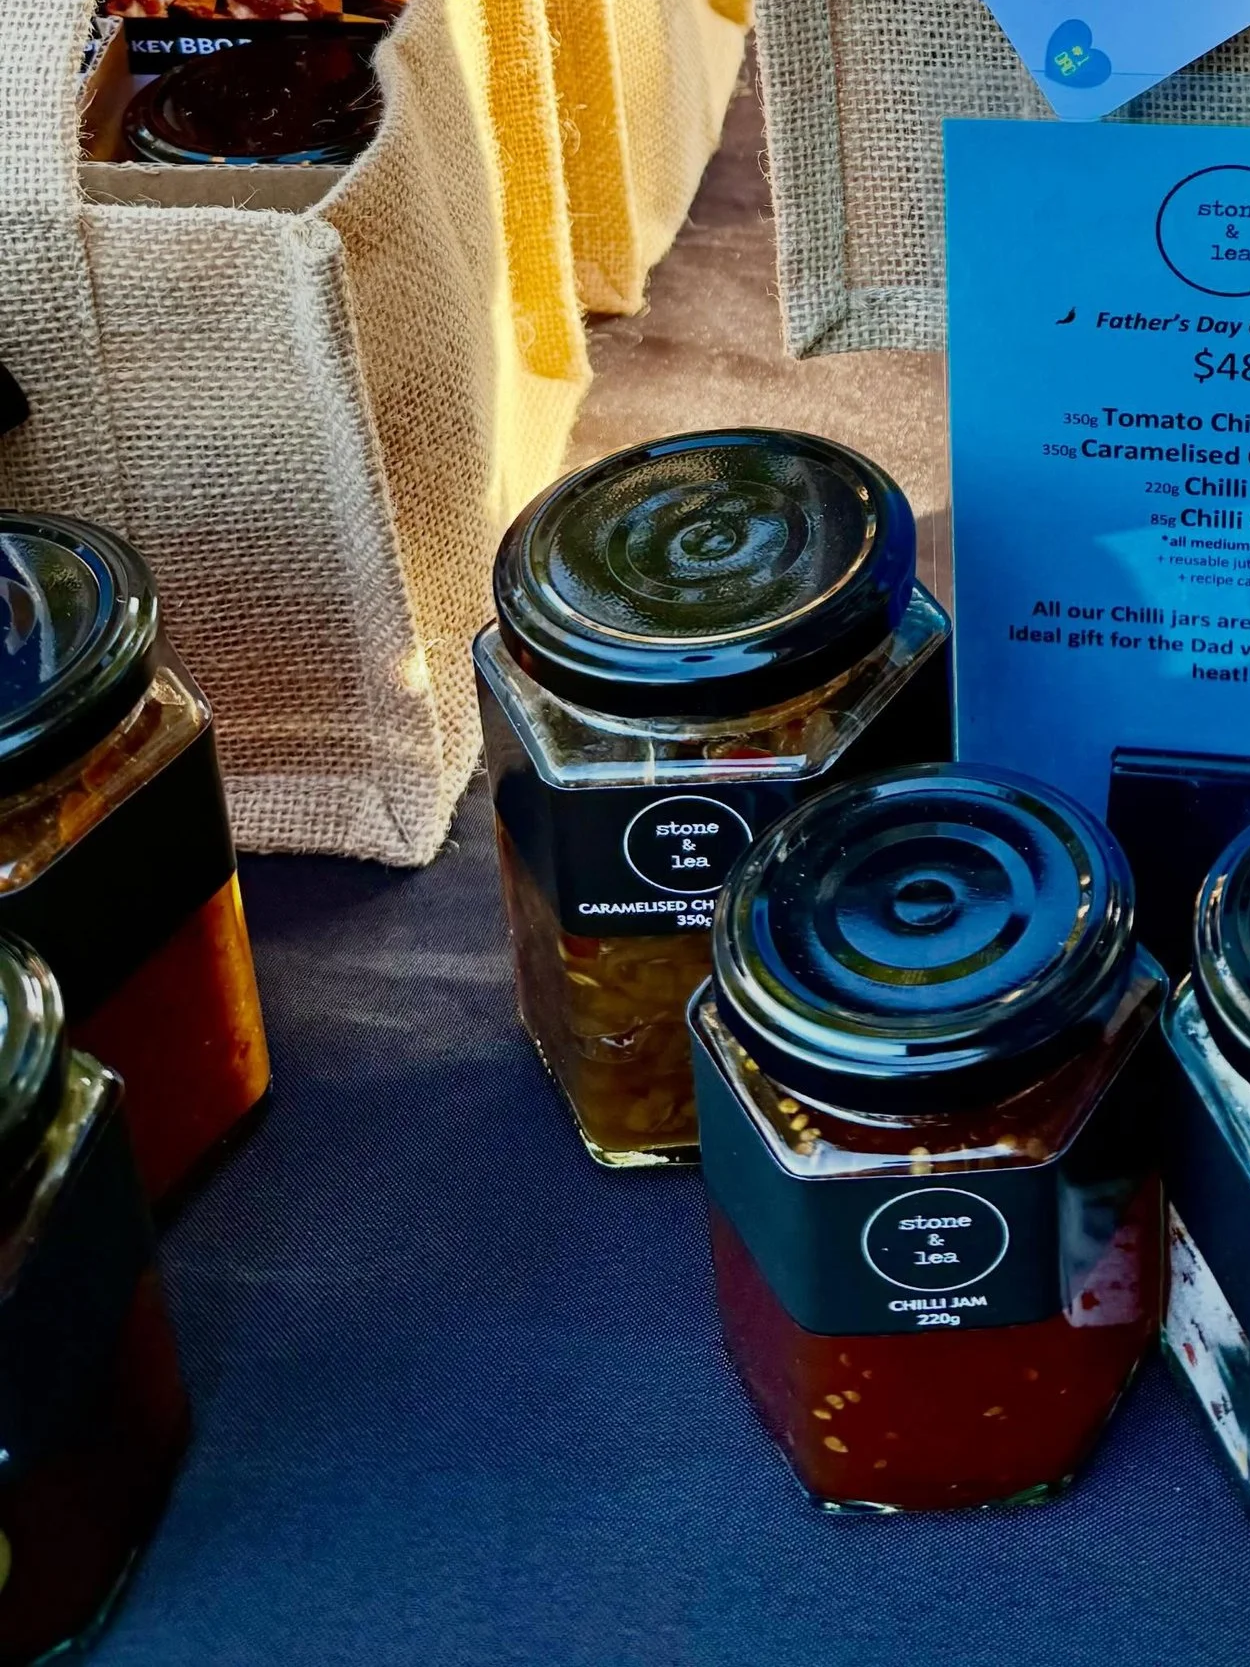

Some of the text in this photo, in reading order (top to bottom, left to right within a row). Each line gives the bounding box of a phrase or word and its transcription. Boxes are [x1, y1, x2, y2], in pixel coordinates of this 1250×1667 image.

[131, 39, 175, 54] KEY
[1225, 224, 1240, 239] &
[1196, 315, 1242, 338] Day
[1063, 411, 1099, 429] 350g
[1102, 406, 1203, 432] Tomato
[1042, 443, 1078, 459] 350g
[1081, 438, 1240, 465] Caramelised
[1145, 480, 1180, 496] 220g
[1185, 477, 1248, 499] Chilli
[1151, 513, 1176, 528] 85g
[1180, 508, 1242, 531] Chilli
[1191, 538, 1250, 551] medium
[1169, 554, 1229, 567] reusable
[1190, 574, 1233, 587] recipe
[1032, 601, 1061, 619] All
[1069, 608, 1105, 621] our
[1111, 603, 1164, 625] Chilli
[1170, 610, 1210, 631] jars
[1069, 628, 1105, 651] gift
[1110, 630, 1139, 648] for
[1147, 633, 1185, 653] the
[1192, 636, 1233, 656] Dad
[1191, 662, 1249, 683] heat!
[656, 821, 719, 836] stone
[682, 839, 696, 851] &
[672, 855, 710, 868] lea
[578, 901, 688, 915] CARAMELISED
[898, 1214, 972, 1230] stone
[929, 1234, 944, 1246] &
[914, 1249, 959, 1265] lea
[888, 1296, 988, 1312] CHILLI JAM
[917, 1313, 960, 1326] 220g
